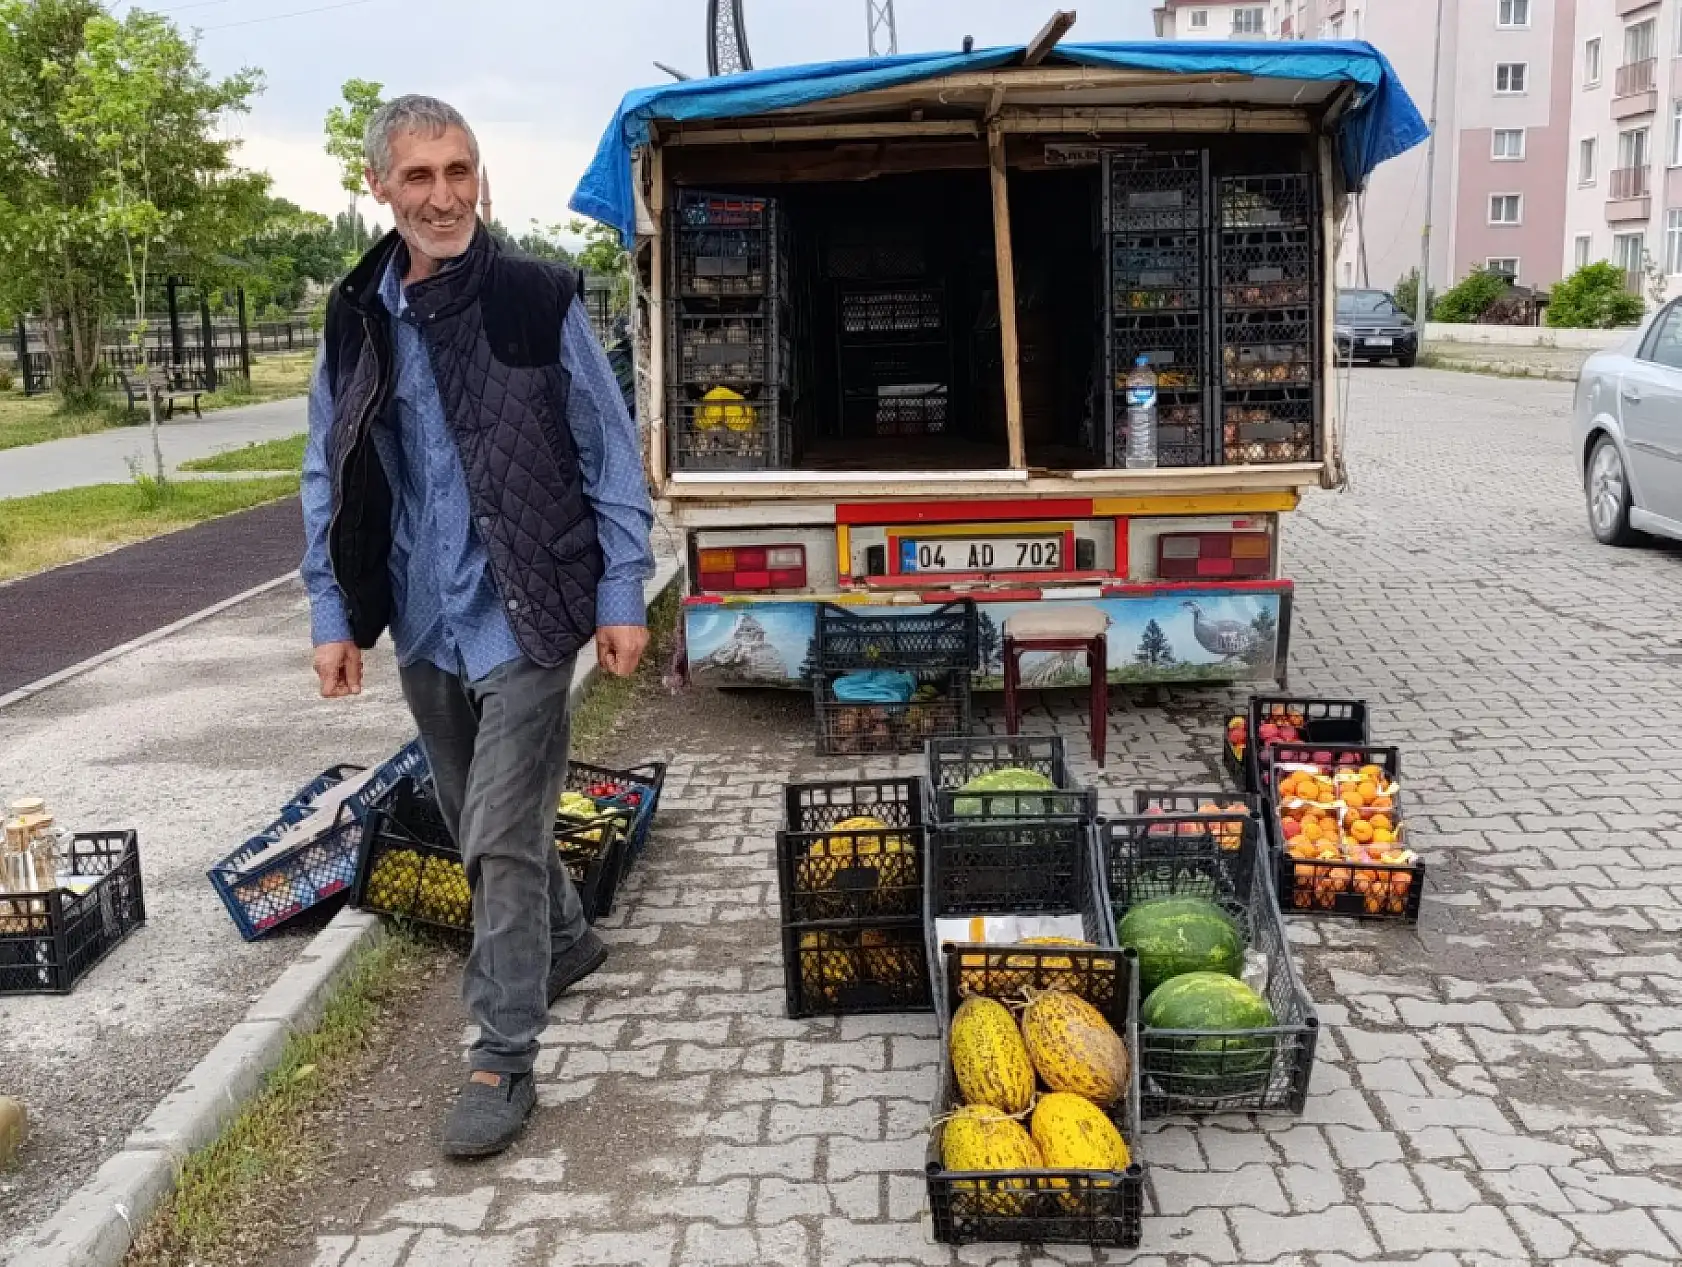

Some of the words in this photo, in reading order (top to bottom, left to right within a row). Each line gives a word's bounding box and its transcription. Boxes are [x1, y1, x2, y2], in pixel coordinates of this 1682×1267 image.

[919, 544, 945, 568] 04
[968, 544, 994, 568] AD
[1016, 542, 1058, 566] 702
